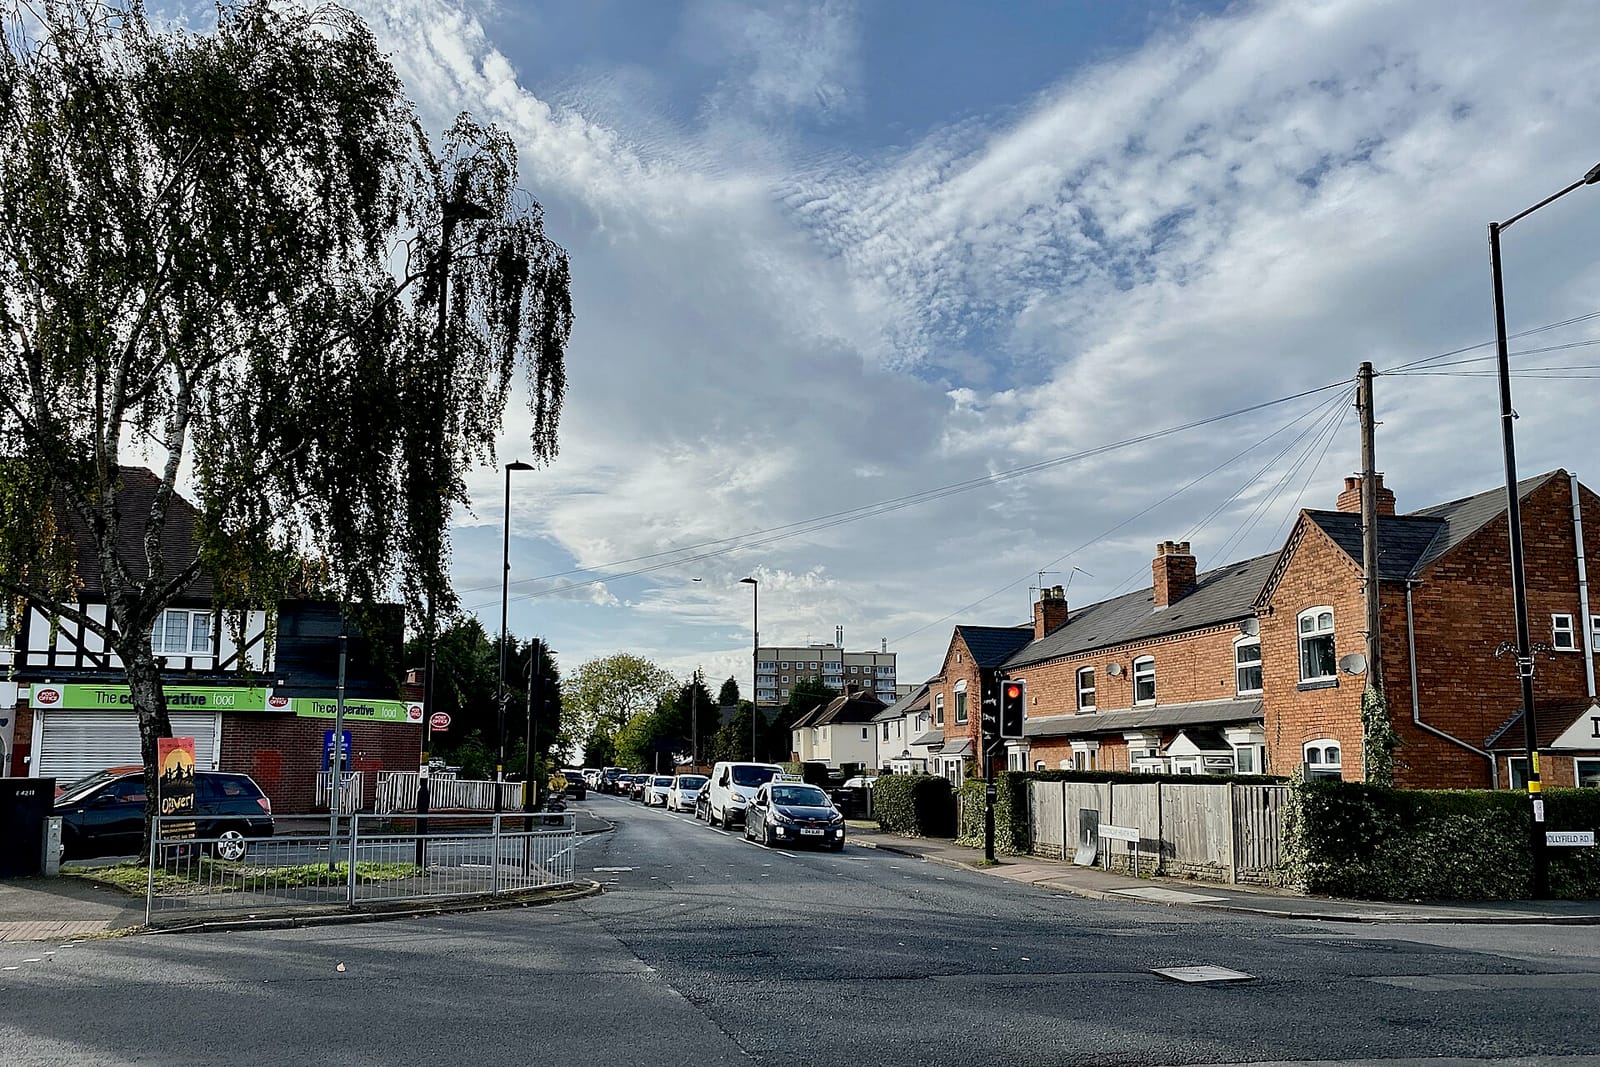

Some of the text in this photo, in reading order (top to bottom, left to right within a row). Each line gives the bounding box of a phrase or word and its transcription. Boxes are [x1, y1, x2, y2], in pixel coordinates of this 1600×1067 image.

[95, 691, 117, 704] The
[212, 693, 235, 705] food
[311, 701, 325, 713] The
[381, 706, 397, 718] food
[1546, 835, 1578, 843] OLLYFIELD
